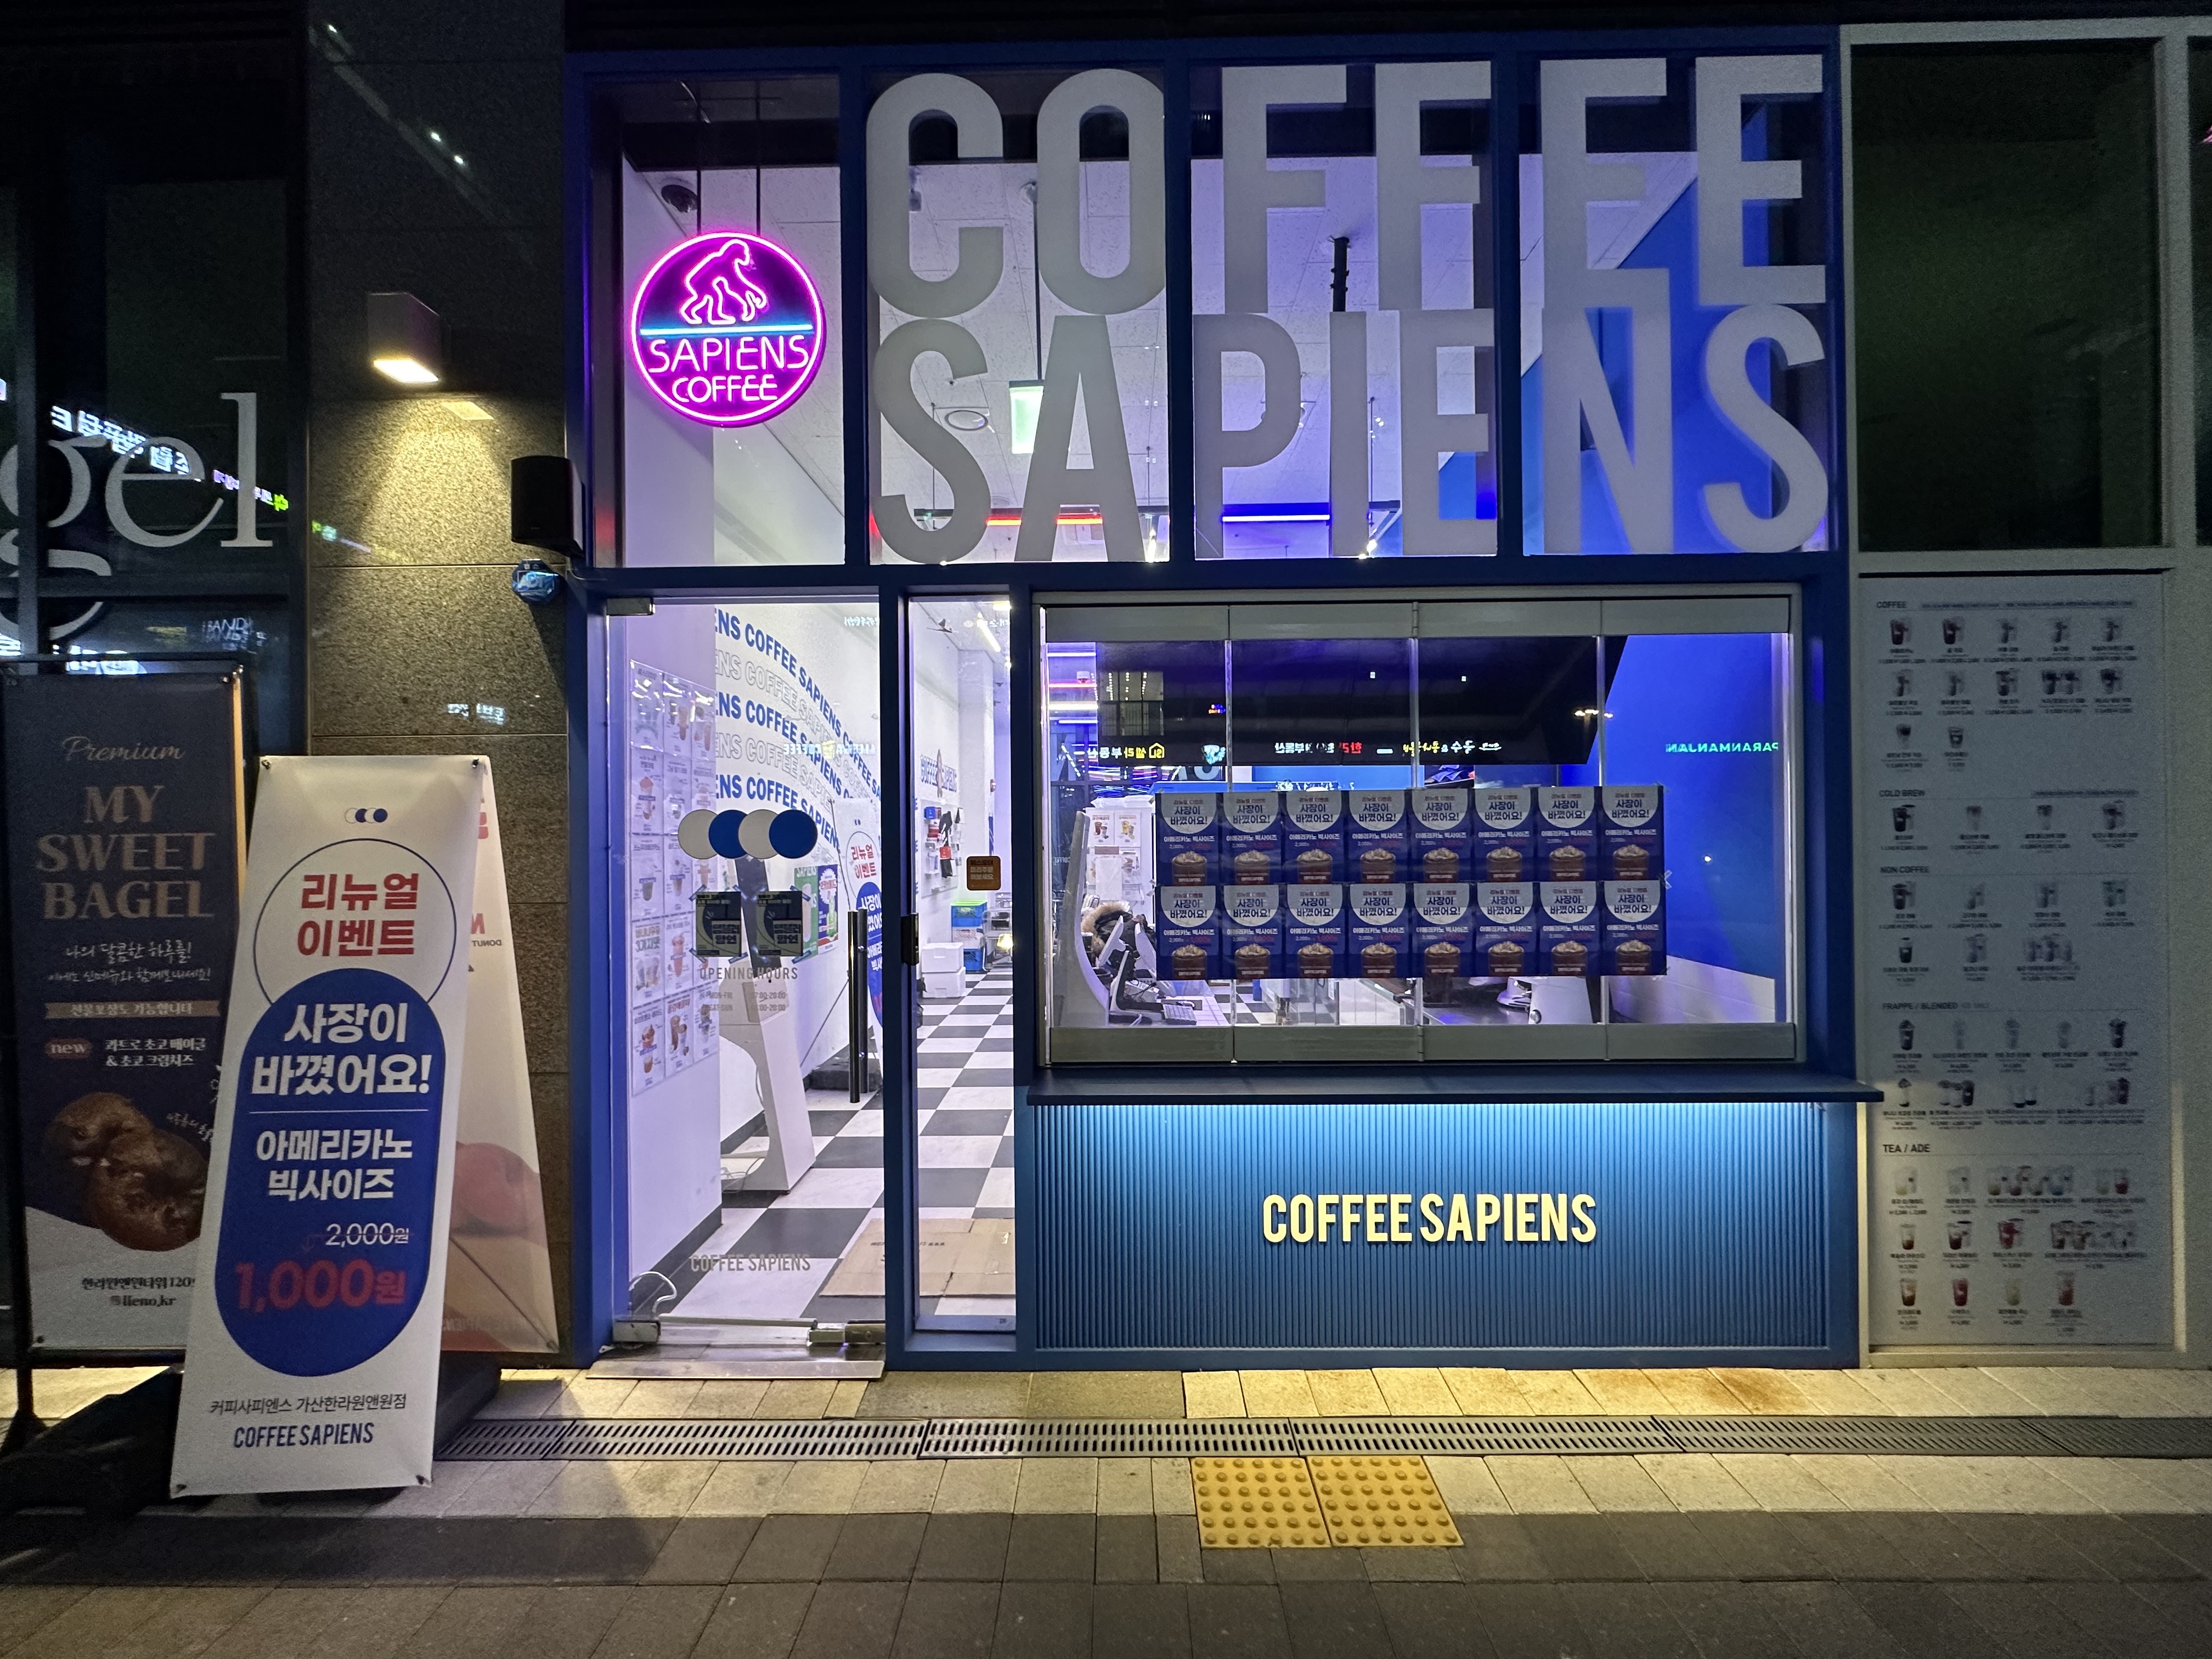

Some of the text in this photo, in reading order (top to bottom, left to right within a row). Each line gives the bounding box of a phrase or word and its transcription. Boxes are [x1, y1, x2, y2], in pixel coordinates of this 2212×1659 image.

[865, 54, 1826, 318] COFFEE
[648, 335, 810, 373] SAPIENS
[671, 374, 778, 403] COFFEE
[872, 303, 1829, 564] SAPIENS
[745, 624, 797, 678] COFFEE
[799, 667, 841, 738] SAPIENS
[746, 699, 798, 745] COFFEE
[63, 736, 185, 761] Premium
[84, 785, 165, 824] MY
[747, 776, 798, 811] COFFEE
[35, 833, 216, 873] SWEET
[42, 879, 215, 919] BAGEL
[301, 873, 420, 911] 리뉴얼
[66, 945, 95, 959] 나의
[100, 942, 145, 964] 달콤한
[297, 919, 415, 957] 이벤트
[699, 967, 798, 980] OPENING HOURS
[284, 1002, 408, 1044] 사장이
[50, 1043, 87, 1054] new
[106, 1055, 118, 1066] &
[251, 1053, 432, 1096] 바꼈어요!
[256, 1129, 413, 1161] 아메리카노
[1883, 1144, 1901, 1153] TEA
[1910, 1144, 1931, 1153] ADE
[268, 1168, 394, 1201] 빅사이즈
[325, 1222, 410, 1248] 2,000원
[1262, 1193, 1597, 1243] COFFEE SAPIENS
[691, 1254, 811, 1272] COFFEE SAPIENS
[235, 1259, 408, 1314] 1,000원
[210, 1393, 407, 1415] 커피사피엔스 가산한라원앤원점
[234, 1422, 375, 1448] COFFEE SAPIENS
